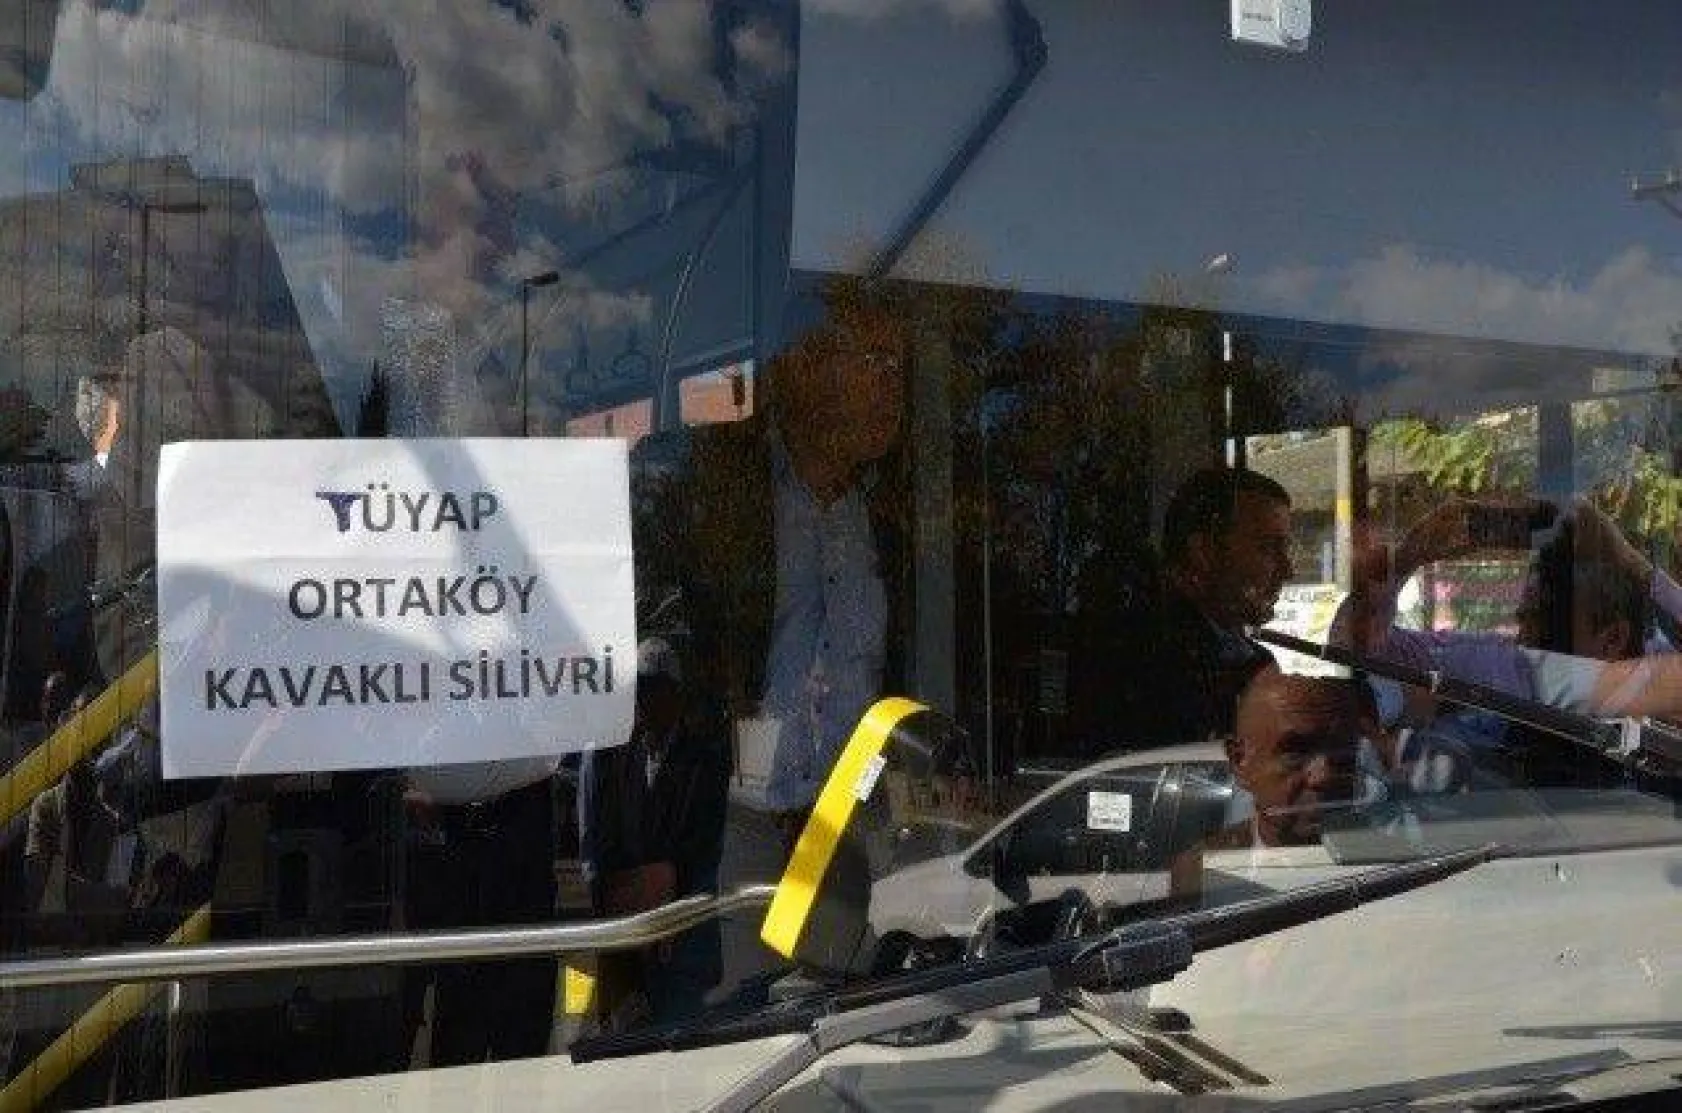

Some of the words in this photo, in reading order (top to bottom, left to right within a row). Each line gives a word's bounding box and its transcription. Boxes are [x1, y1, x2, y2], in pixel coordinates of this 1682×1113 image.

[315, 481, 499, 532] TÜYAP
[288, 565, 539, 620] ORTAKÖY
[206, 662, 431, 710] KAVAKLI
[450, 646, 615, 700] SİLİVRİ
